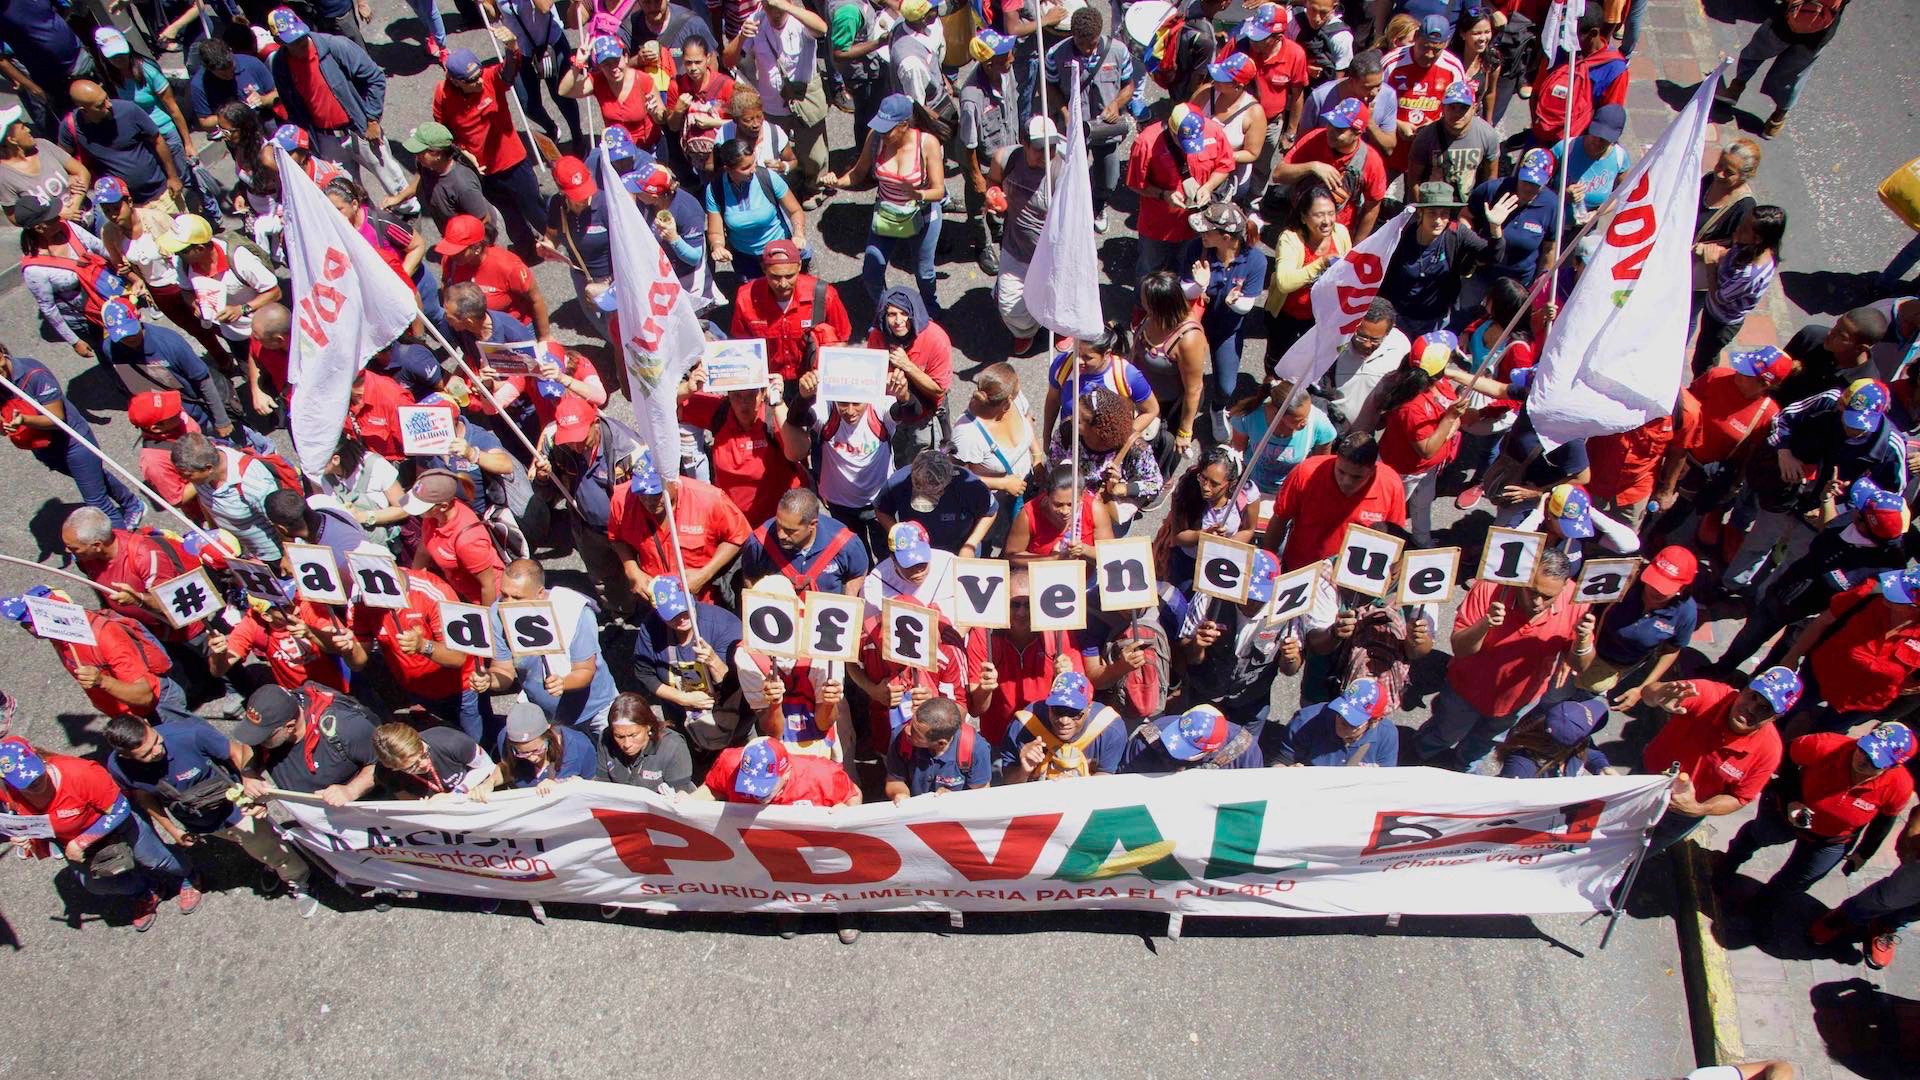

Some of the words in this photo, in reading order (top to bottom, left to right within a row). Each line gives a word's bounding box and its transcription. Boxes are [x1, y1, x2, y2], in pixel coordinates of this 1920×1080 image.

[591, 800, 1309, 885] PDVAL
[640, 882, 811, 903] SEGURIDAD
[820, 887, 1029, 902] ALIMENTARIA
[1035, 886, 1119, 902] PARA
[1128, 887, 1165, 900] EL
